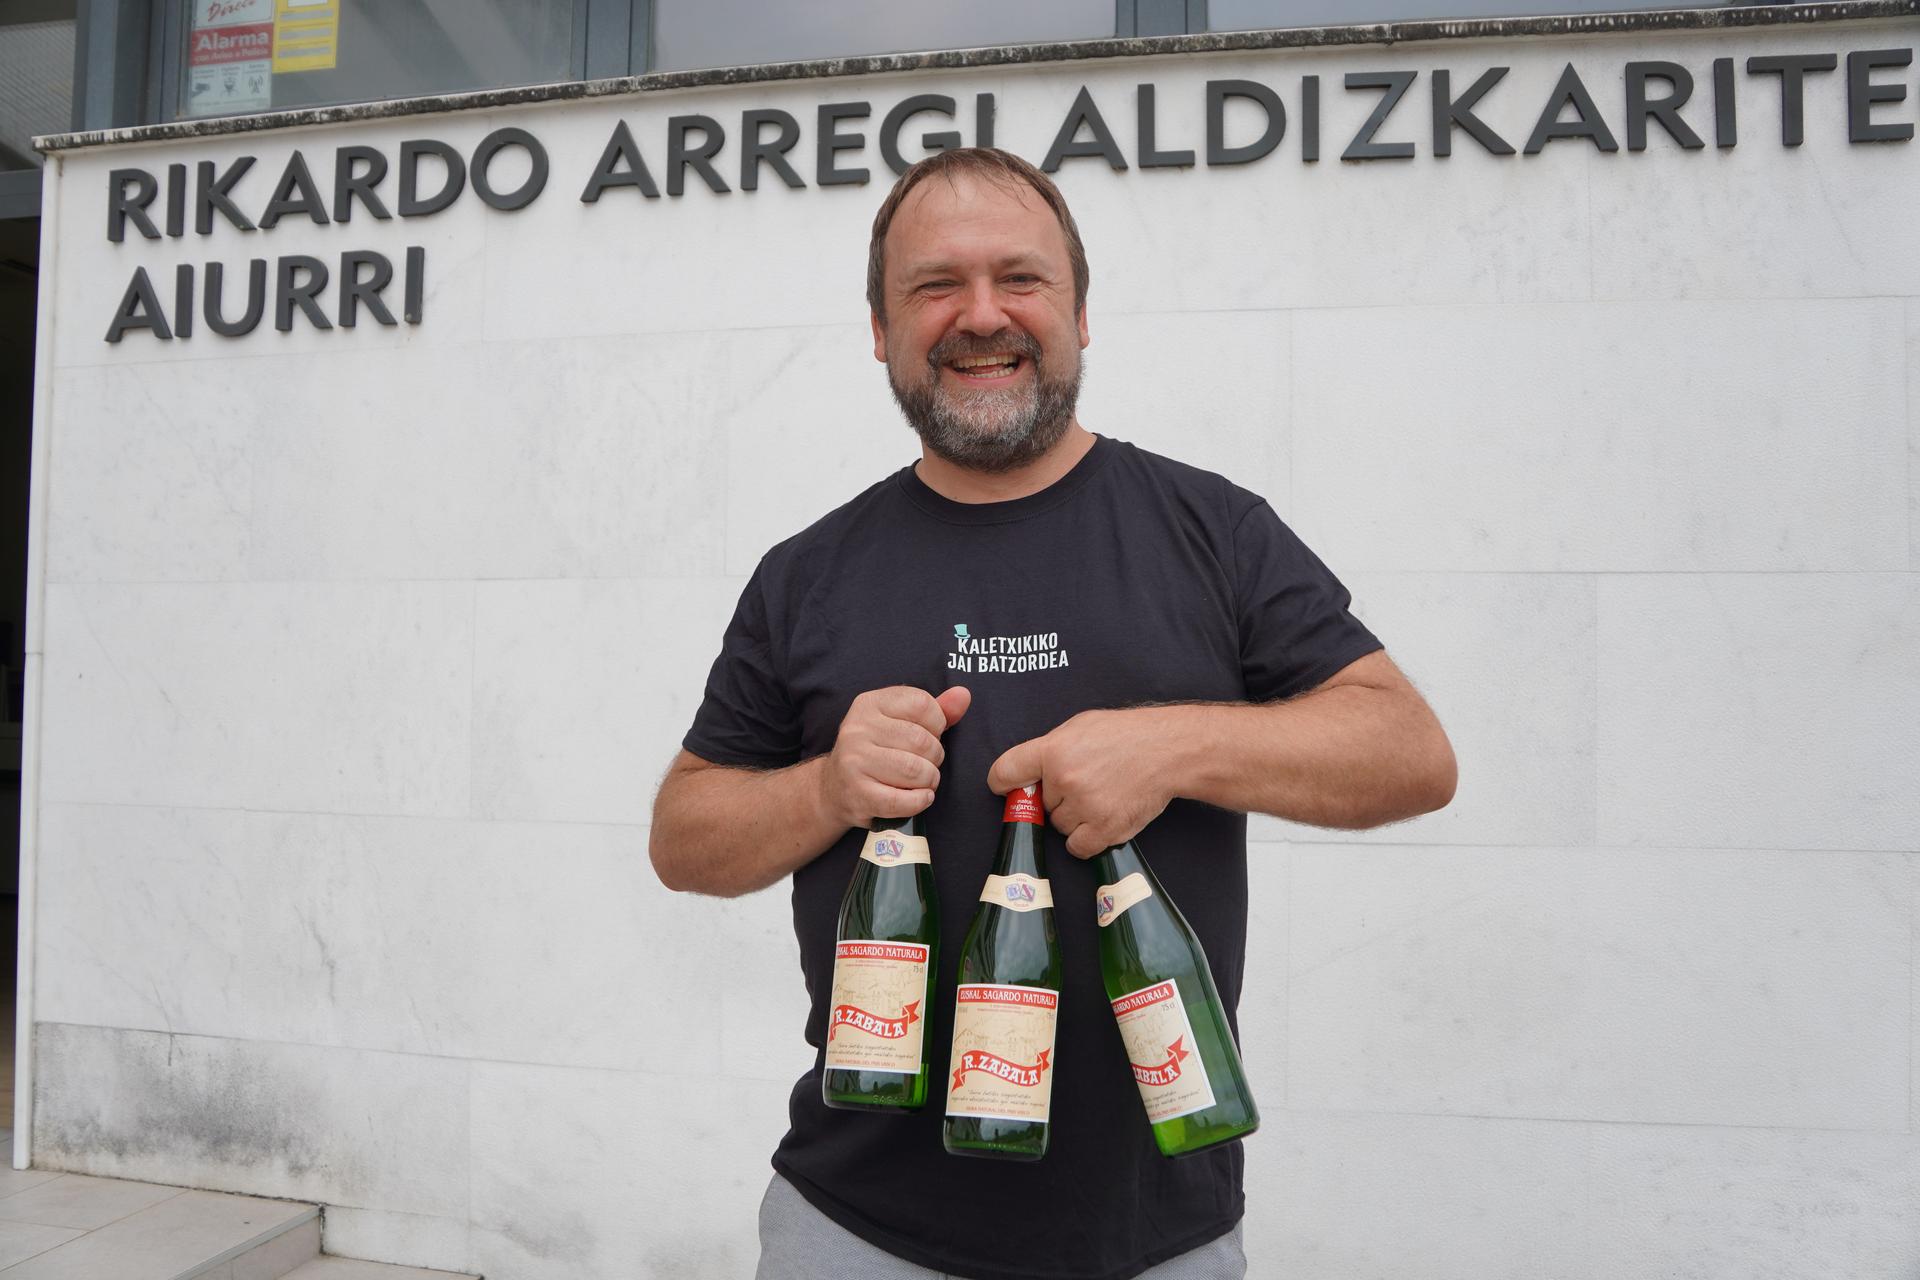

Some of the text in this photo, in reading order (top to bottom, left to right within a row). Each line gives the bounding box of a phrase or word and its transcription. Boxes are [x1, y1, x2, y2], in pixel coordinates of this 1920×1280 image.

[196, 32, 269, 51] Alarma
[107, 48, 1914, 242] RIKARDO ARREGI ALDIZKARITE
[104, 246, 425, 343] AIURRI
[957, 632, 1058, 654] KALETXIKIKO
[947, 650, 1069, 673] JAI BATZORDEA
[850, 946, 884, 956] SAGARDO
[886, 947, 923, 960] NATURALA
[982, 991, 1021, 1002] SAGARDO
[1022, 993, 1055, 1006] NATURALA
[1131, 986, 1170, 1008] NATURALA
